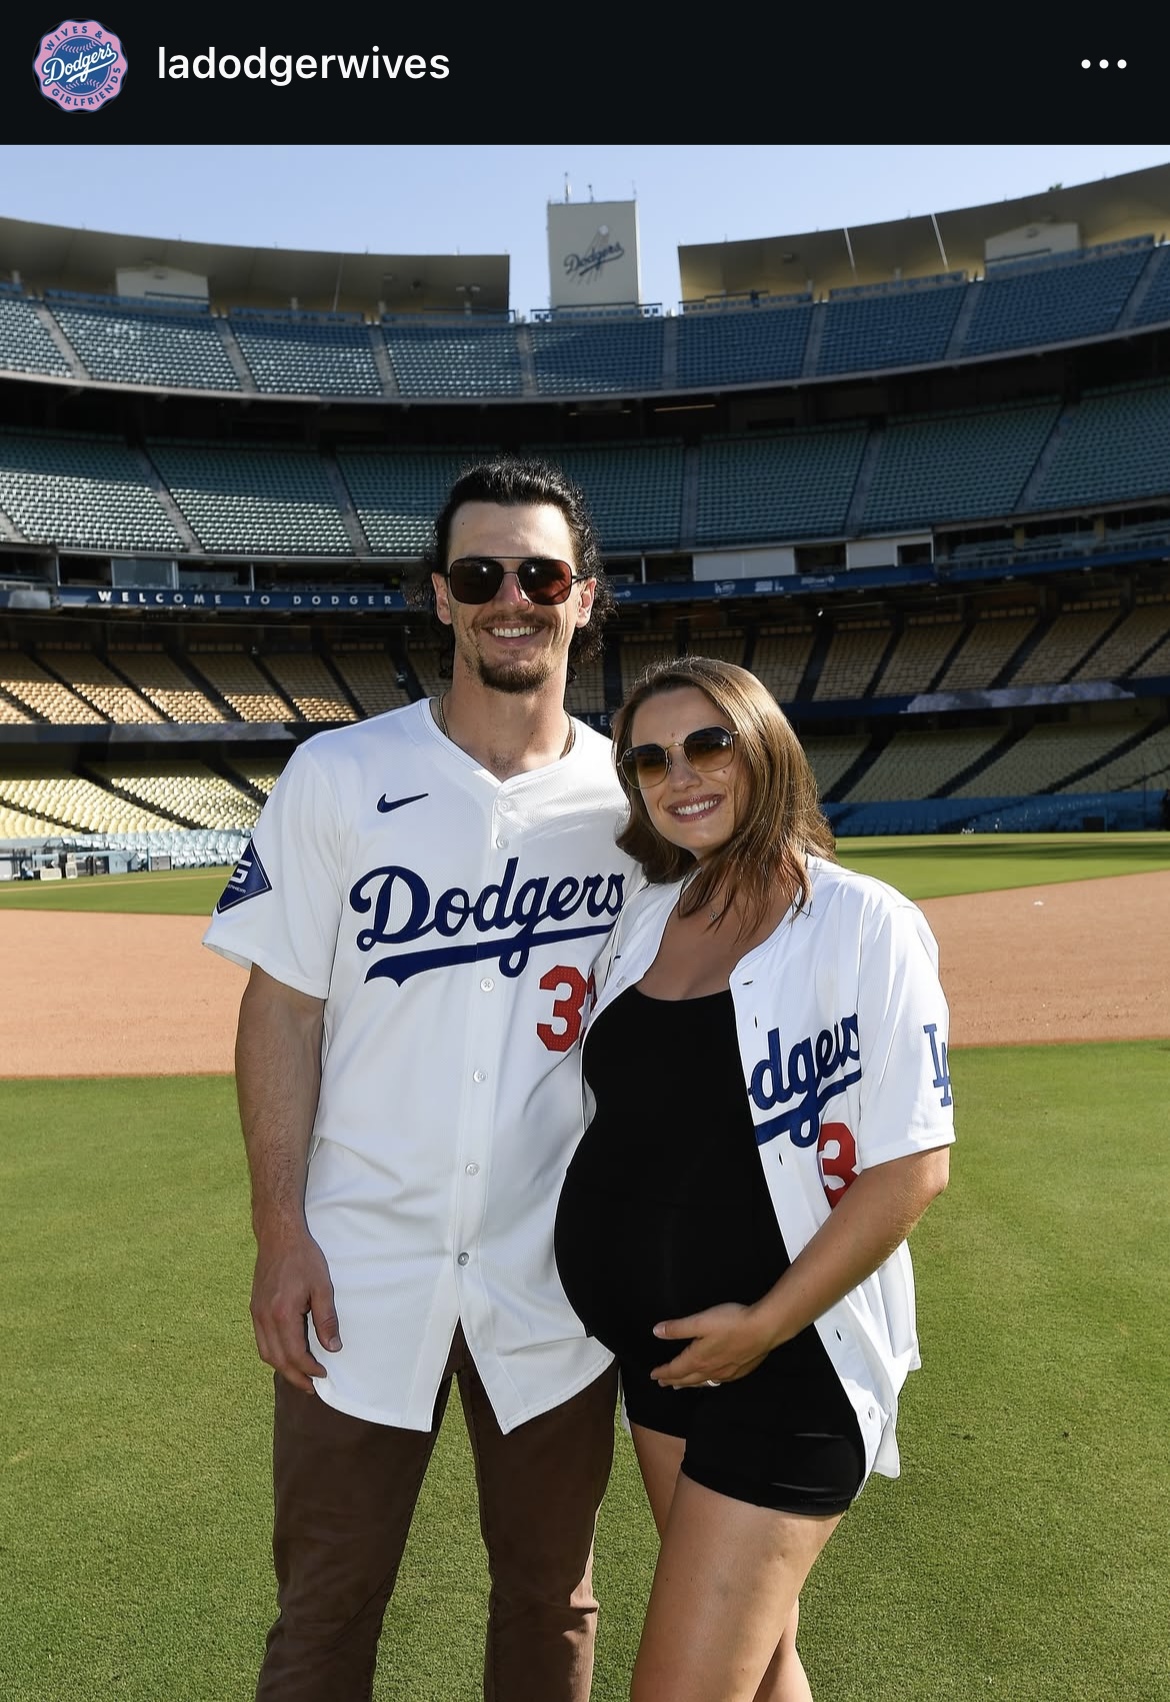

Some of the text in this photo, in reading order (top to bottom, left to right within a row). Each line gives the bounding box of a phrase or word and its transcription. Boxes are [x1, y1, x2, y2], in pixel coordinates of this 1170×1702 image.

[563, 241, 624, 276] Dodgers
[98, 591, 392, 605] WELCOME TO DODGER
[349, 857, 625, 978] Dodgers
